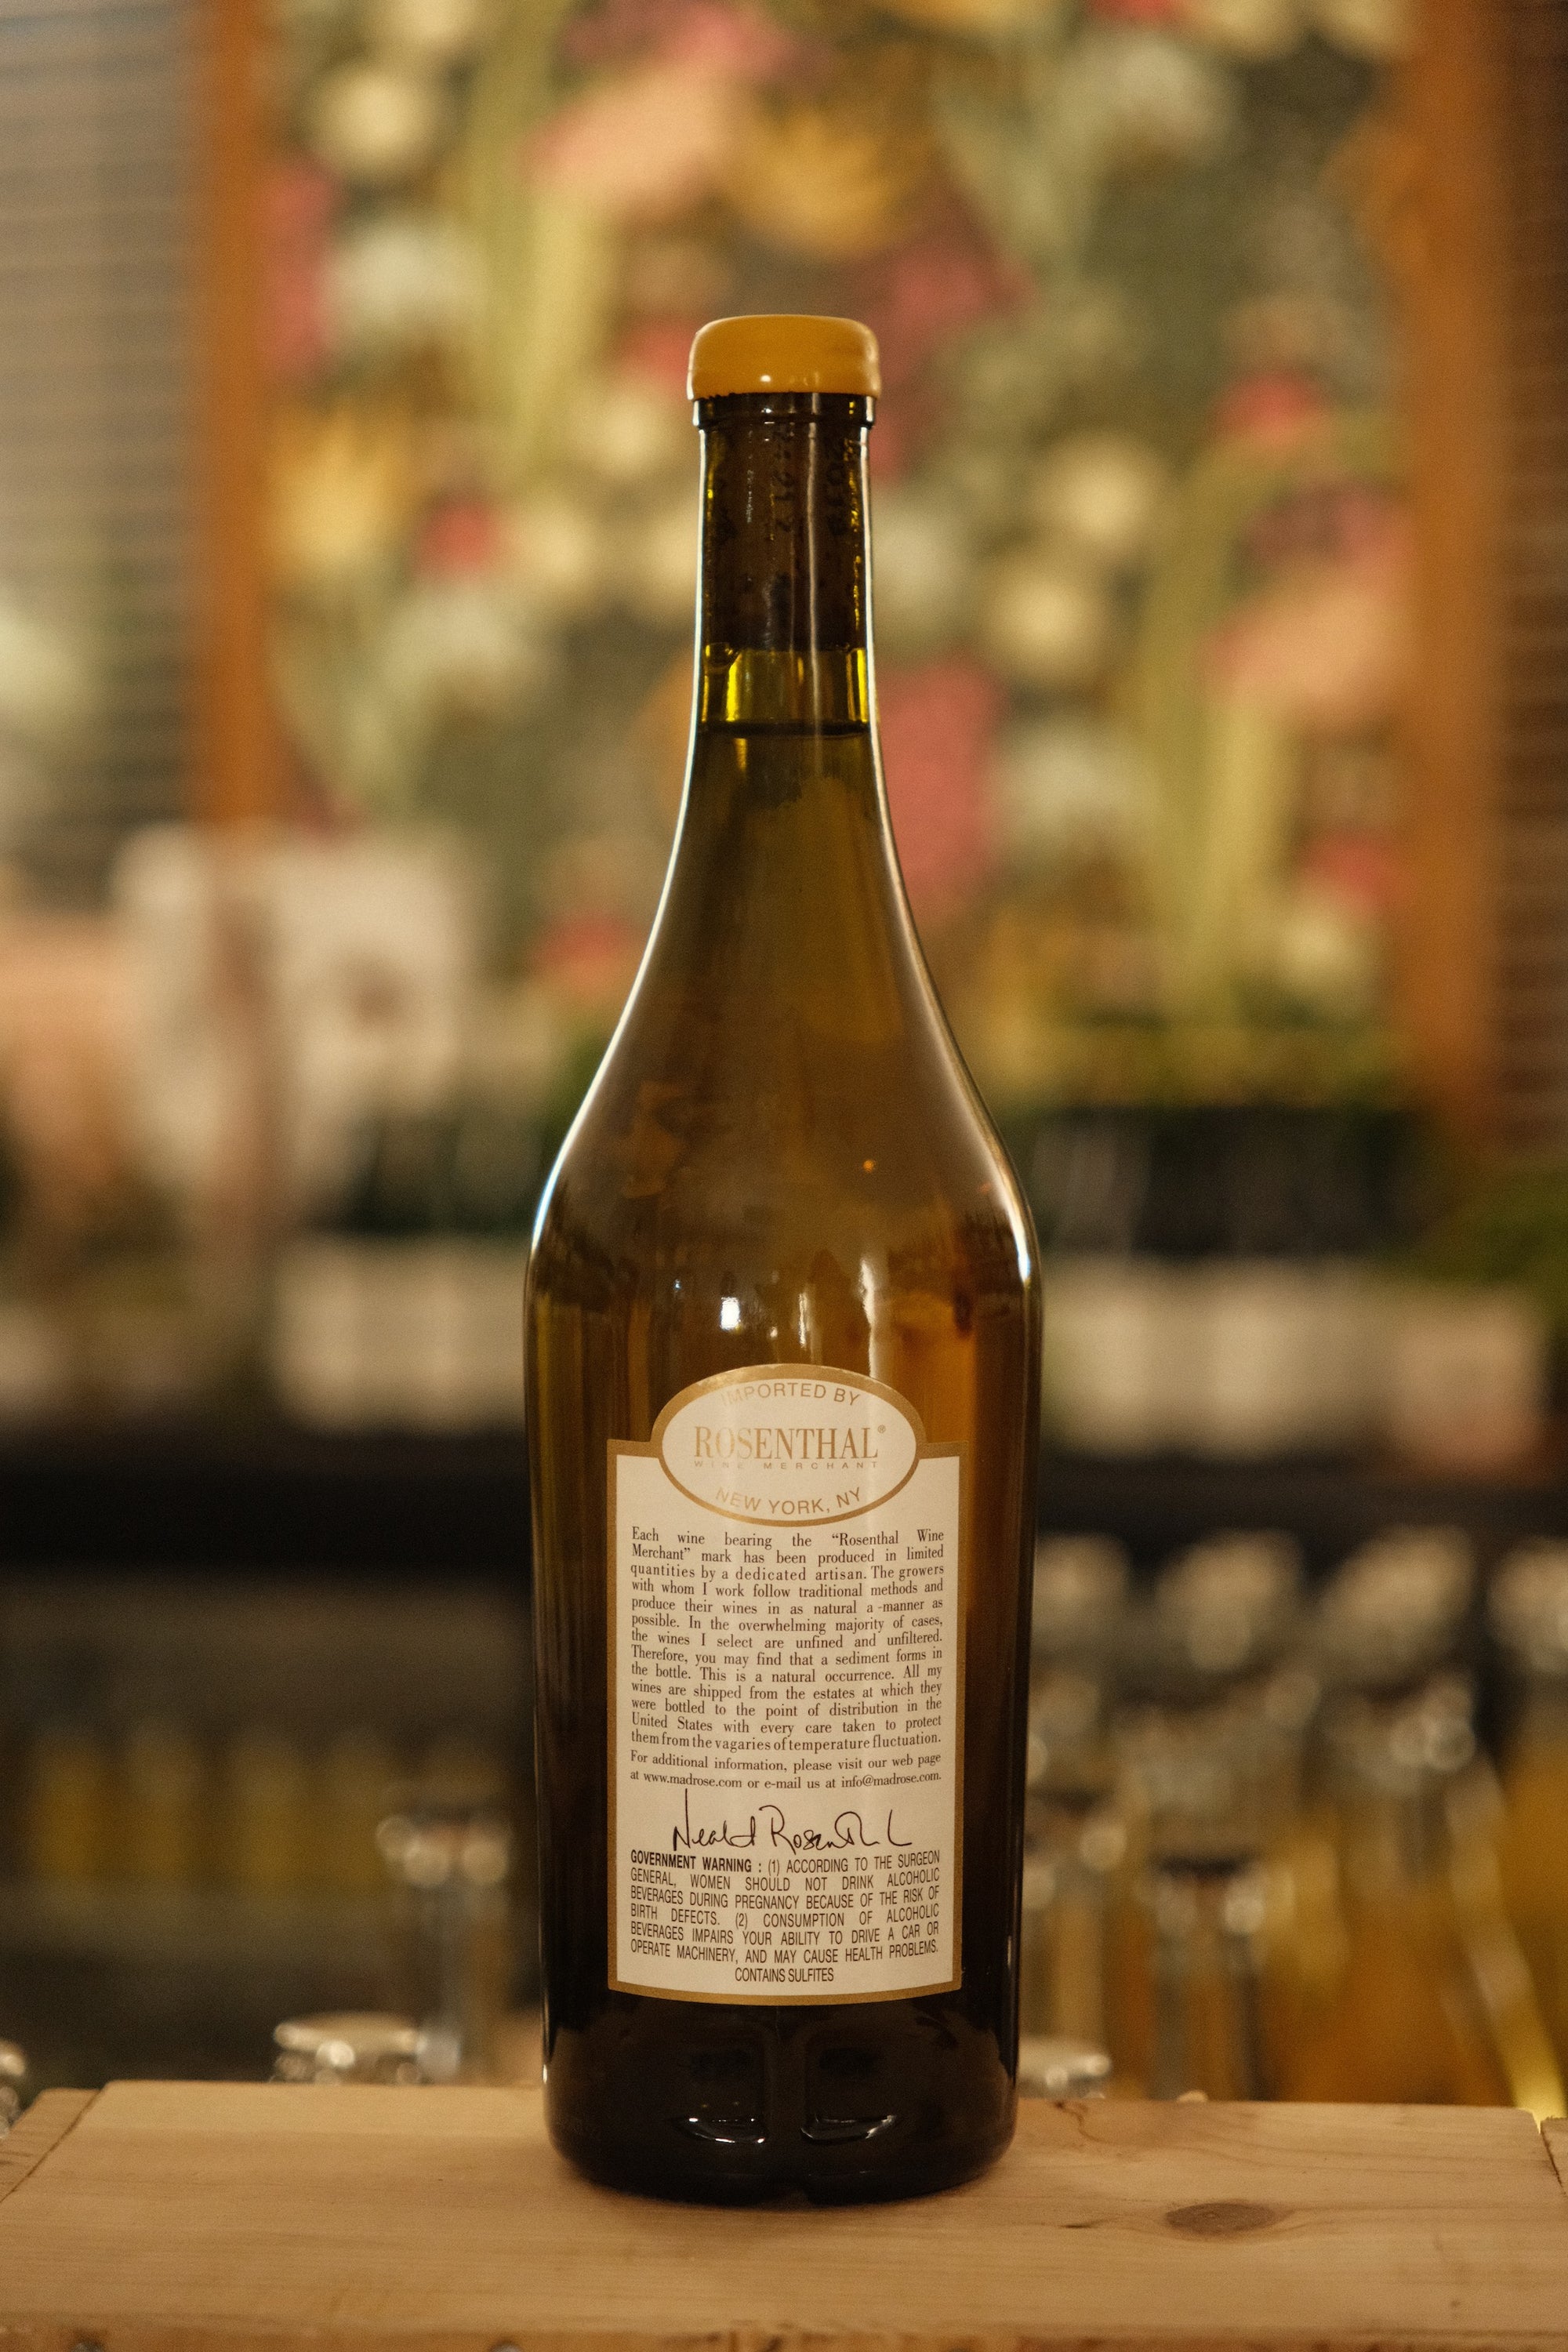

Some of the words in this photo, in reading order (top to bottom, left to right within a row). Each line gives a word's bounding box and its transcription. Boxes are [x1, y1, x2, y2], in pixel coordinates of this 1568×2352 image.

[720, 1382, 826, 1406] IMPORTED
[833, 1388, 861, 1407] BY
[764, 1461, 878, 1469] MERCHANT
[715, 1486, 761, 1512] NEW
[769, 1498, 831, 1515] YORK,
[837, 1486, 862, 1508] NY
[632, 1526, 659, 1541] Each
[677, 1530, 705, 1544] wine
[724, 1532, 772, 1550] bearing
[792, 1533, 811, 1547] the
[916, 1529, 944, 1542] Wine
[702, 1548, 731, 1563] mark
[744, 1549, 764, 1563] has
[776, 1549, 806, 1563] been
[818, 1548, 874, 1567] produced
[907, 1544, 943, 1560] limited
[630, 1563, 695, 1581] quantities
[701, 1565, 716, 1583] by
[735, 1566, 806, 1581] dedicated
[815, 1567, 866, 1581] artisan.
[871, 1565, 895, 1579] The
[898, 1566, 944, 1581] growers
[632, 1578, 654, 1592] with
[662, 1581, 695, 1595] whom
[715, 1583, 744, 1597] work
[753, 1583, 790, 1597] follow
[799, 1582, 862, 1598] traditional
[871, 1581, 918, 1595] methods
[924, 1578, 943, 1592] and
[632, 1595, 675, 1612] produce
[684, 1598, 713, 1613] their
[722, 1601, 757, 1614] wines
[814, 1599, 857, 1614] natural
[632, 1613, 680, 1629] possible.
[710, 1616, 729, 1630] the
[739, 1617, 826, 1635] overwhelming
[836, 1617, 884, 1635] majority
[911, 1617, 942, 1628] cases,
[632, 1628, 648, 1642] the
[658, 1631, 690, 1645] wines
[717, 1634, 753, 1648] select
[764, 1639, 784, 1649] are
[796, 1634, 843, 1649] unfined
[854, 1633, 876, 1647] and
[887, 1629, 942, 1646] unfiltered.
[631, 1644, 688, 1664] Therefore,
[695, 1654, 716, 1667] you
[724, 1656, 749, 1668] may
[757, 1651, 782, 1665] find
[789, 1651, 813, 1666] that
[836, 1650, 889, 1665] sediment
[896, 1648, 927, 1662] forms
[631, 1661, 648, 1675] the
[655, 1663, 691, 1679] bottle.
[699, 1666, 726, 1681] This
[771, 1668, 815, 1682] natural
[825, 1671, 895, 1682] occurrence.
[903, 1664, 920, 1679] All
[927, 1667, 942, 1679] my
[631, 1679, 662, 1694] wines
[668, 1686, 687, 1696] are
[693, 1683, 742, 1702] shipped
[750, 1686, 778, 1700] from
[786, 1686, 805, 1700] the
[813, 1687, 855, 1700] estates
[880, 1681, 913, 1697] which
[920, 1679, 942, 1696] they
[632, 1700, 656, 1710] were
[665, 1697, 705, 1714] bottled
[736, 1702, 756, 1716] the
[765, 1704, 797, 1721] point
[808, 1702, 821, 1716] of
[829, 1700, 898, 1716] distribution
[926, 1696, 942, 1710] the
[632, 1711, 668, 1728] United
[677, 1715, 713, 1731] States
[724, 1719, 750, 1733] with
[760, 1725, 794, 1737] every
[805, 1724, 832, 1733] care
[843, 1719, 875, 1733] taken
[906, 1715, 941, 1733] protect
[631, 1728, 659, 1744] them
[662, 1731, 689, 1747] from
[692, 1733, 712, 1748] the
[715, 1737, 771, 1753] vagaries
[773, 1737, 787, 1751] of
[789, 1737, 870, 1755] temperature
[873, 1731, 941, 1748] fluctuation.
[631, 1749, 648, 1762] For
[652, 1752, 708, 1768] additional
[714, 1757, 787, 1772] information,
[793, 1759, 832, 1774] please
[838, 1757, 862, 1769] visit
[868, 1759, 887, 1768] our
[891, 1753, 913, 1766] web
[918, 1755, 941, 1768] page
[644, 1773, 742, 1788] www.madrose.com
[764, 1777, 801, 1789] e-mail
[630, 1849, 696, 1870] GOVERNMENT
[768, 1859, 780, 1876] (1)
[786, 1857, 848, 1874] ACCORDING
[855, 1857, 868, 1871] TO
[873, 1855, 892, 1870] THE
[898, 1849, 940, 1868] SURGEON
[630, 1867, 677, 1888] GENERAL,
[690, 1874, 731, 1889] WOMEN
[745, 1876, 790, 1892] SHOULD
[805, 1876, 828, 1892] NOT
[842, 1875, 874, 1890] DRINK
[887, 1867, 940, 1887] ALCOHOLIC
[630, 1885, 684, 1905] BEVERAGES
[690, 1892, 728, 1908] DURING
[735, 1894, 800, 1910] PREGNANCY
[806, 1893, 854, 1910] BECAUSE
[860, 1892, 873, 1907] OF
[879, 1890, 898, 1906] THE
[903, 1887, 924, 1904] RISK
[928, 1885, 940, 1900] OF
[630, 1903, 658, 1920] BIRTH
[671, 1907, 720, 1926] DEFECTS.
[735, 1912, 748, 1930] (2)
[763, 1912, 844, 1928] CONSUMPTION
[859, 1910, 873, 1926] OF
[887, 1903, 939, 1923] ALCOHOLIC
[630, 1920, 684, 1941] BEVERAGES
[692, 1928, 734, 1944] IMPAIRS
[742, 1930, 772, 1946] YOUR
[780, 1931, 820, 1946] ABILITY
[829, 1930, 843, 1945] TO
[851, 1928, 880, 1944] DRIVE
[902, 1924, 920, 1940] CAR
[927, 1921, 939, 1936] OR
[630, 1938, 670, 1958] OPERATE
[677, 1944, 738, 1965] MACHINERY,
[745, 1949, 768, 1964] AND
[774, 1950, 797, 1964] MAY
[803, 1948, 838, 1964] CAUSE
[845, 1946, 883, 1962] HEALTH
[889, 1938, 938, 1958] PROBLEMS.
[735, 1967, 786, 1983] CONTAINS
[788, 1967, 834, 1983] SULFITES
